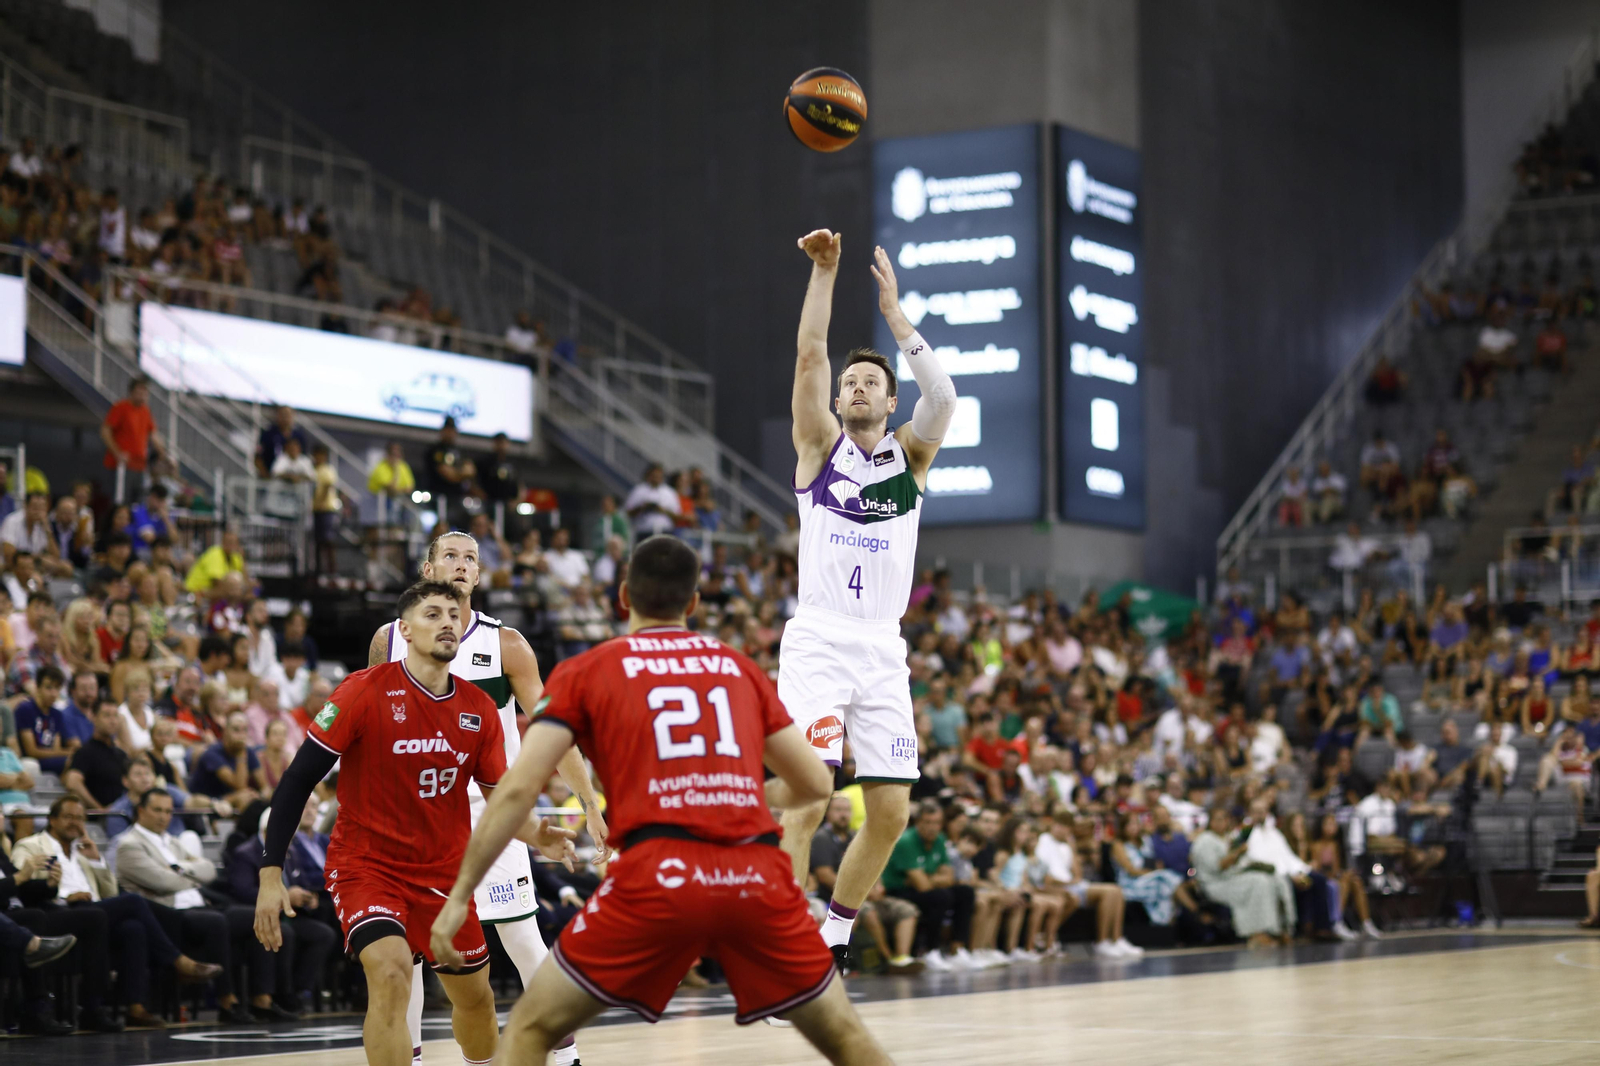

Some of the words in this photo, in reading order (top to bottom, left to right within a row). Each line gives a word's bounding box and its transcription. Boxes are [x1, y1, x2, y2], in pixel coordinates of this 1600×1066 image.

[848, 565, 863, 599] 4
[622, 655, 742, 679] PULEVA
[386, 689, 406, 697] vive
[647, 686, 741, 759] 21
[418, 767, 458, 798] 99
[659, 795, 683, 808] DE
[684, 788, 759, 807] GRANADA
